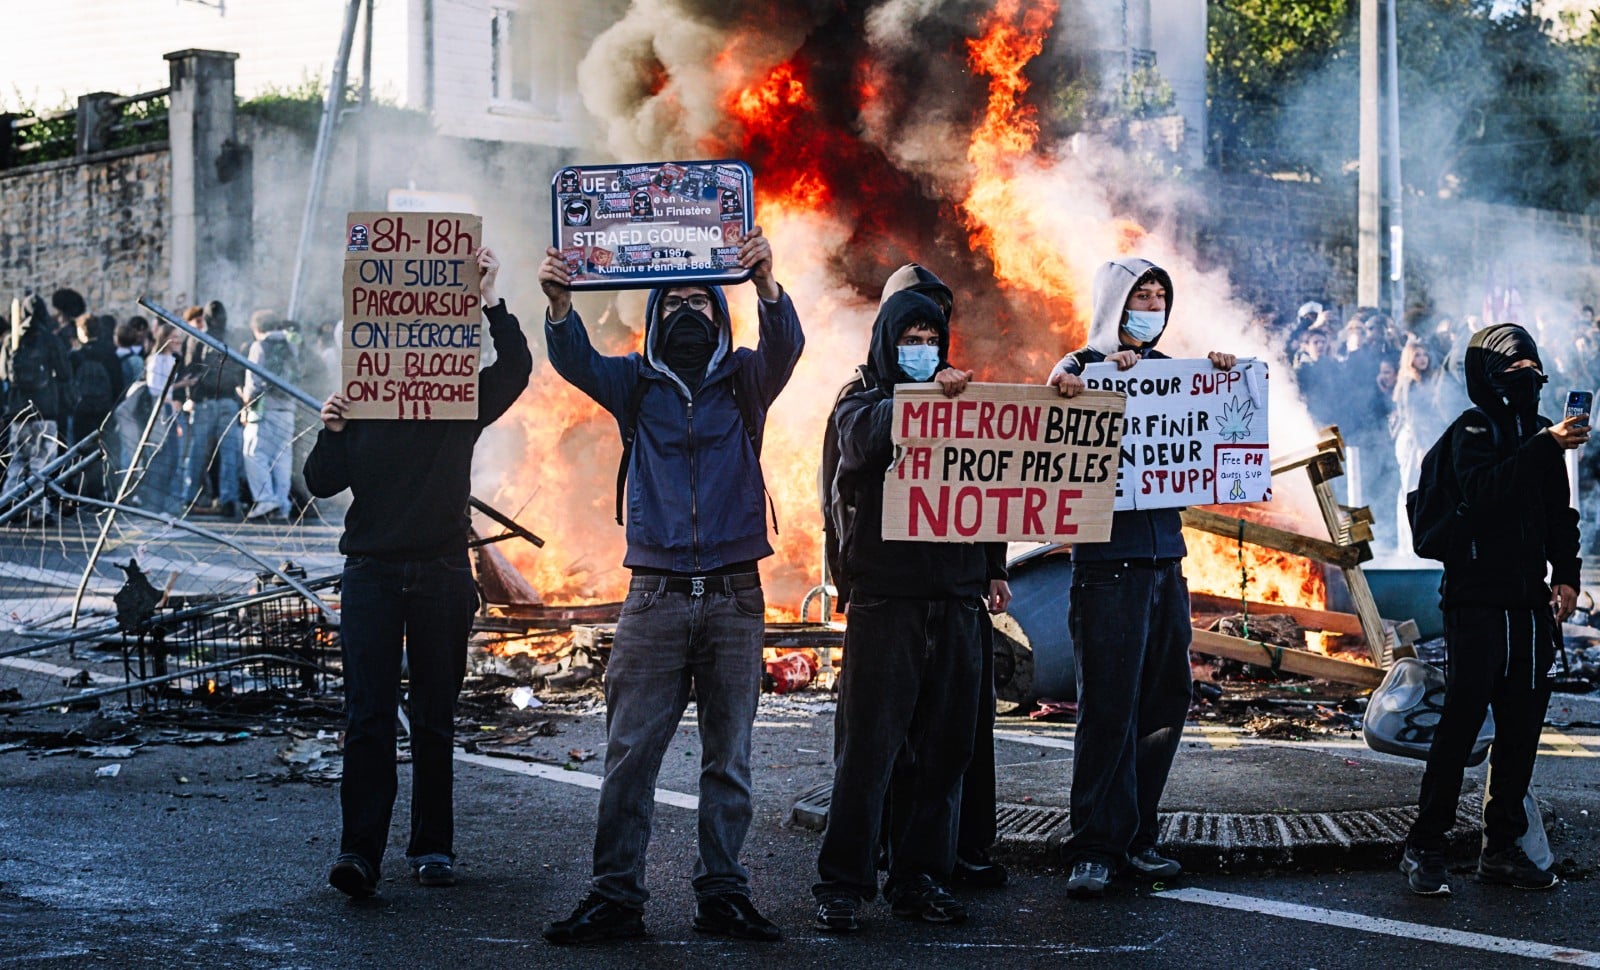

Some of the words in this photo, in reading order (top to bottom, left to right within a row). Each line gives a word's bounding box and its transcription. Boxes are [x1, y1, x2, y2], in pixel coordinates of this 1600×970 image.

[582, 177, 606, 192] UE
[666, 205, 711, 217] Finistère
[573, 229, 642, 247] STRAED
[647, 226, 722, 244] GOUENO
[360, 259, 393, 285] ON
[404, 260, 469, 291] SUBI,
[352, 287, 478, 317] PARCOURSUP
[351, 321, 389, 348] ON
[396, 319, 480, 348] DÉCROCHE
[357, 352, 390, 377] AU
[405, 352, 475, 378] BLOCUS
[346, 381, 379, 402] ON
[383, 380, 475, 402] S'ACCROCHE
[1087, 376, 1182, 397] PARCOUR
[1190, 371, 1241, 396] SUPP
[901, 401, 1042, 441] MACRON
[1044, 406, 1123, 448] BAISE
[943, 447, 1013, 482] PROF
[1222, 452, 1241, 466] Free
[1244, 452, 1264, 466] PH
[1141, 468, 1215, 495] STUPP
[1245, 470, 1262, 479] SVP
[908, 485, 1083, 537] NOTRE
